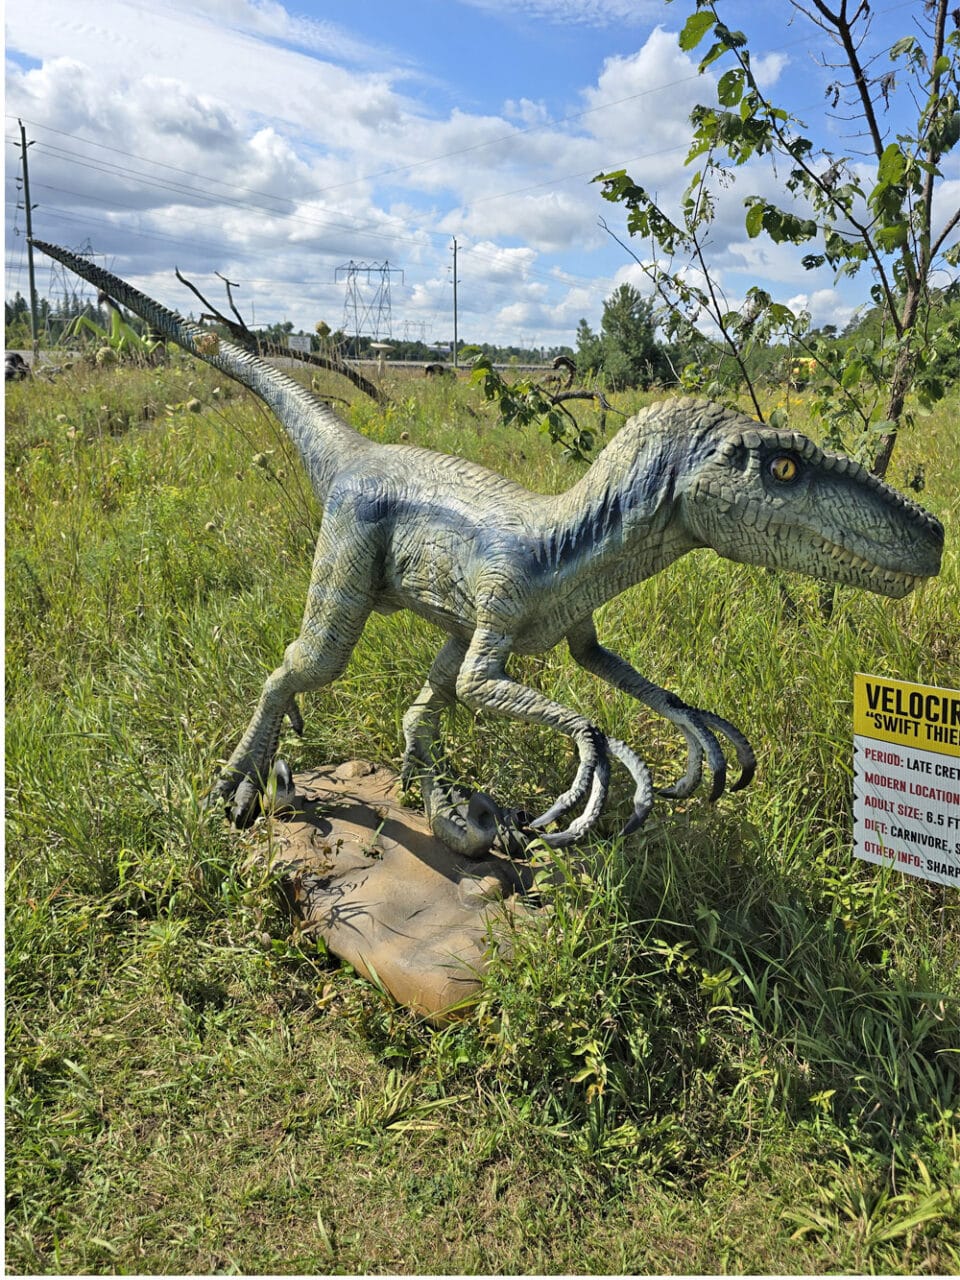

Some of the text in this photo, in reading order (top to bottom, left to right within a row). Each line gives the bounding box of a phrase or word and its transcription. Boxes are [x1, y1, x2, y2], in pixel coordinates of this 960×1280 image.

[866, 683, 960, 726] VELOCIR
[925, 723, 960, 746] THIE
[865, 748, 904, 767] PERIOD:
[907, 757, 932, 774] LATE
[865, 771, 960, 806] MODERN LOCATION
[865, 795, 960, 830] ADULT SIZE: 6.5 FT
[865, 818, 888, 834] DIET:
[891, 825, 952, 853] CARNIVORE,
[865, 841, 895, 859] OTHER
[898, 850, 924, 868] INFO:
